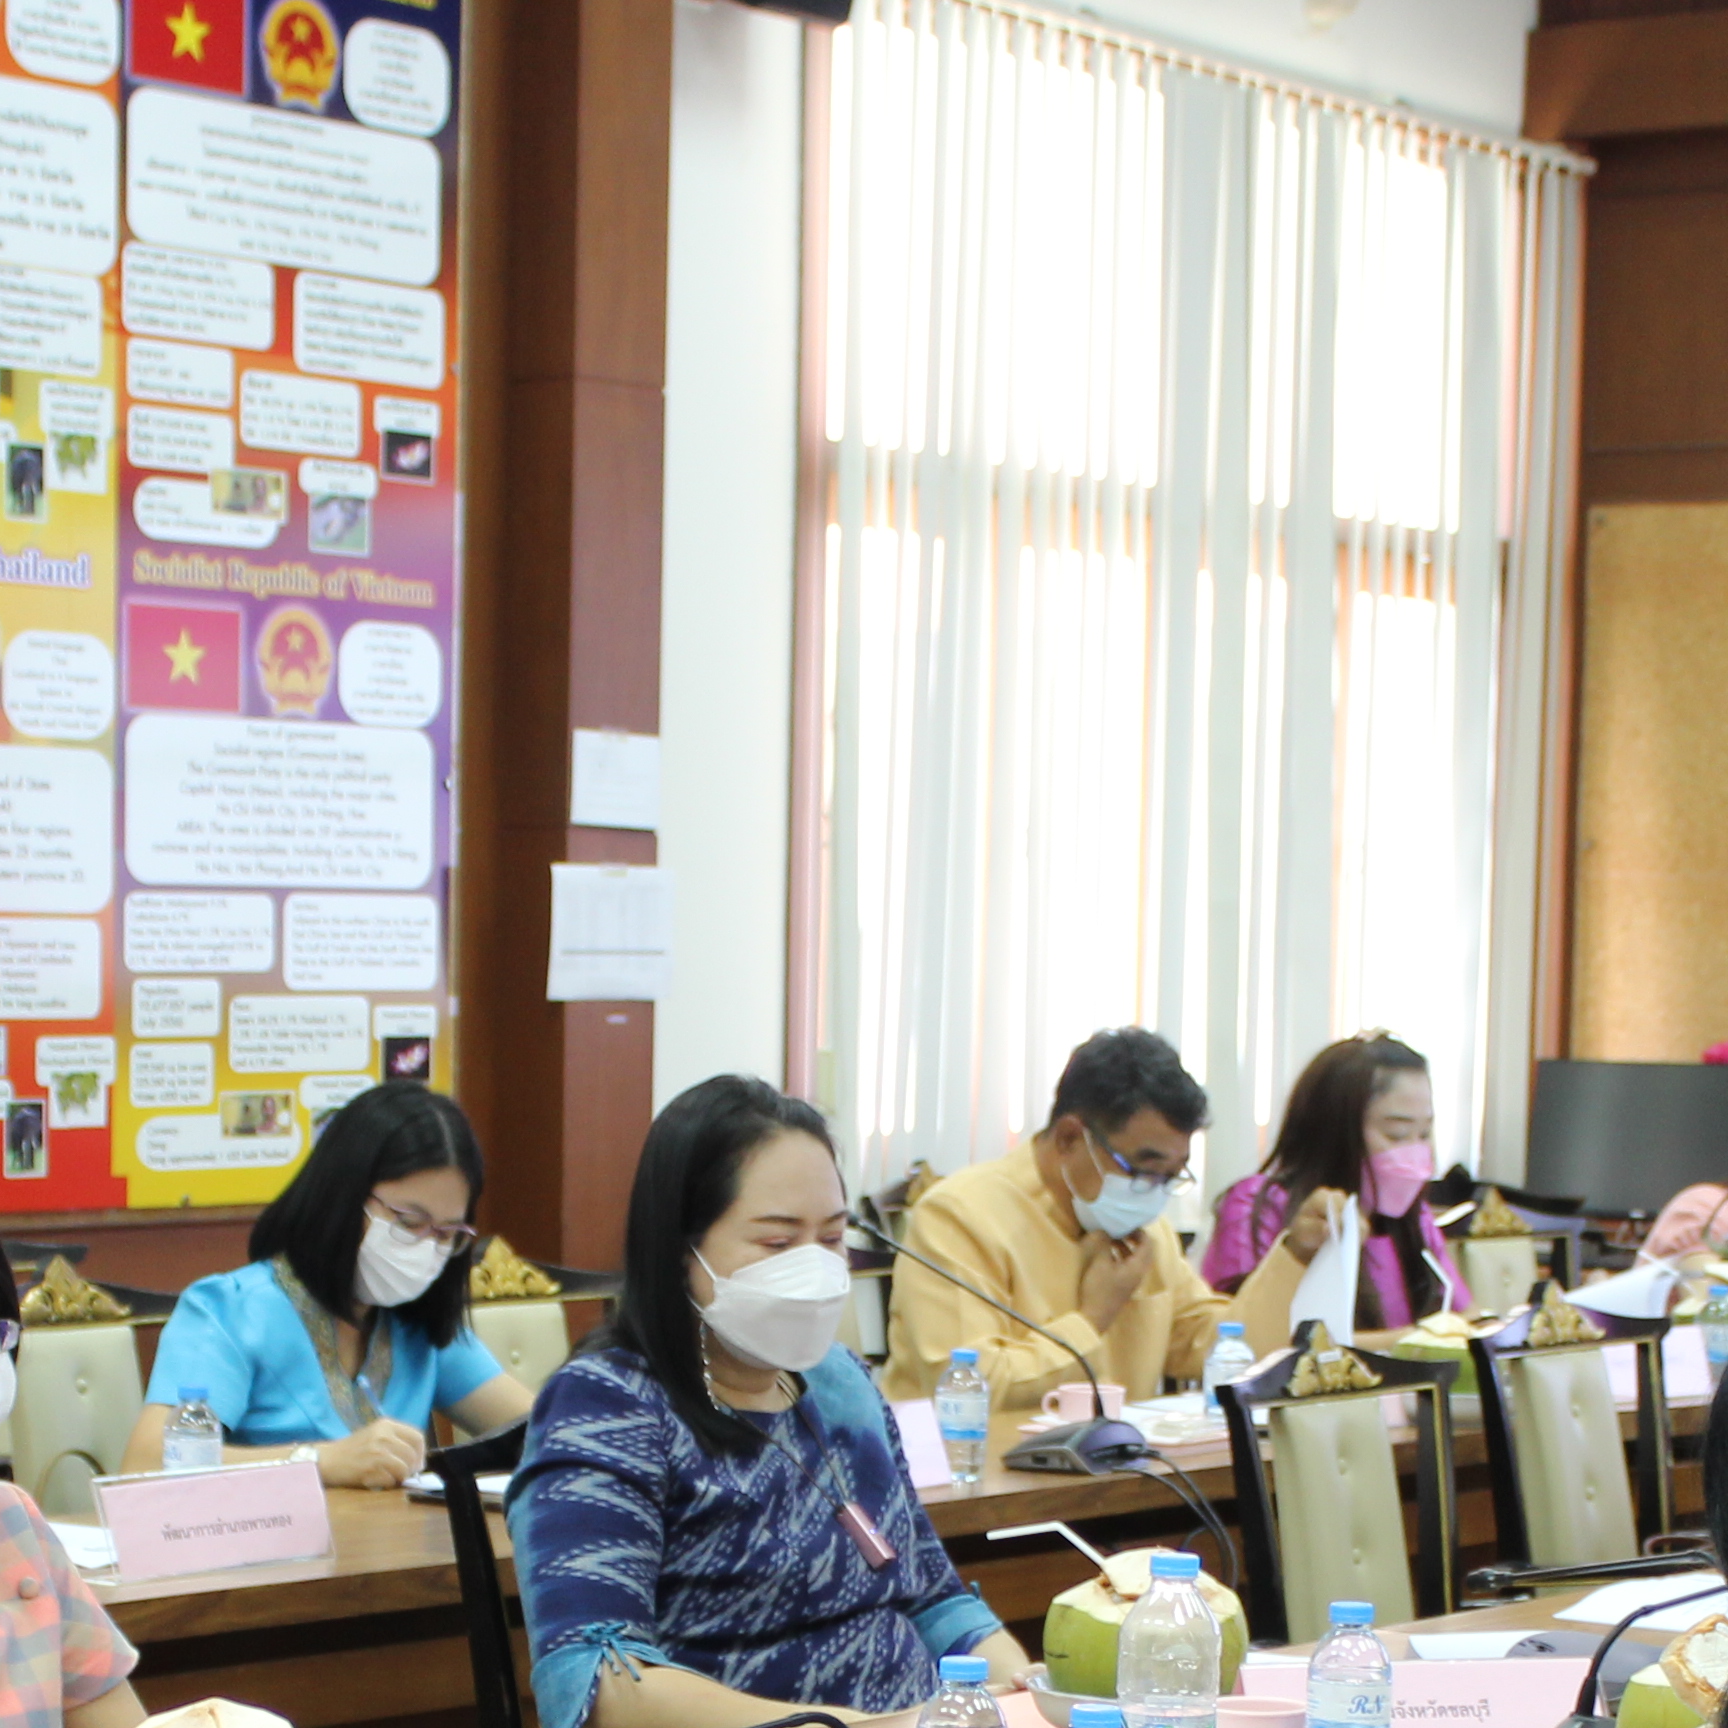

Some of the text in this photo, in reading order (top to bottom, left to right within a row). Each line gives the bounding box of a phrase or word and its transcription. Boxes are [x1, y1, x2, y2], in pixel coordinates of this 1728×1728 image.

[134, 553, 434, 605] Socialist Republic of Vietnam
